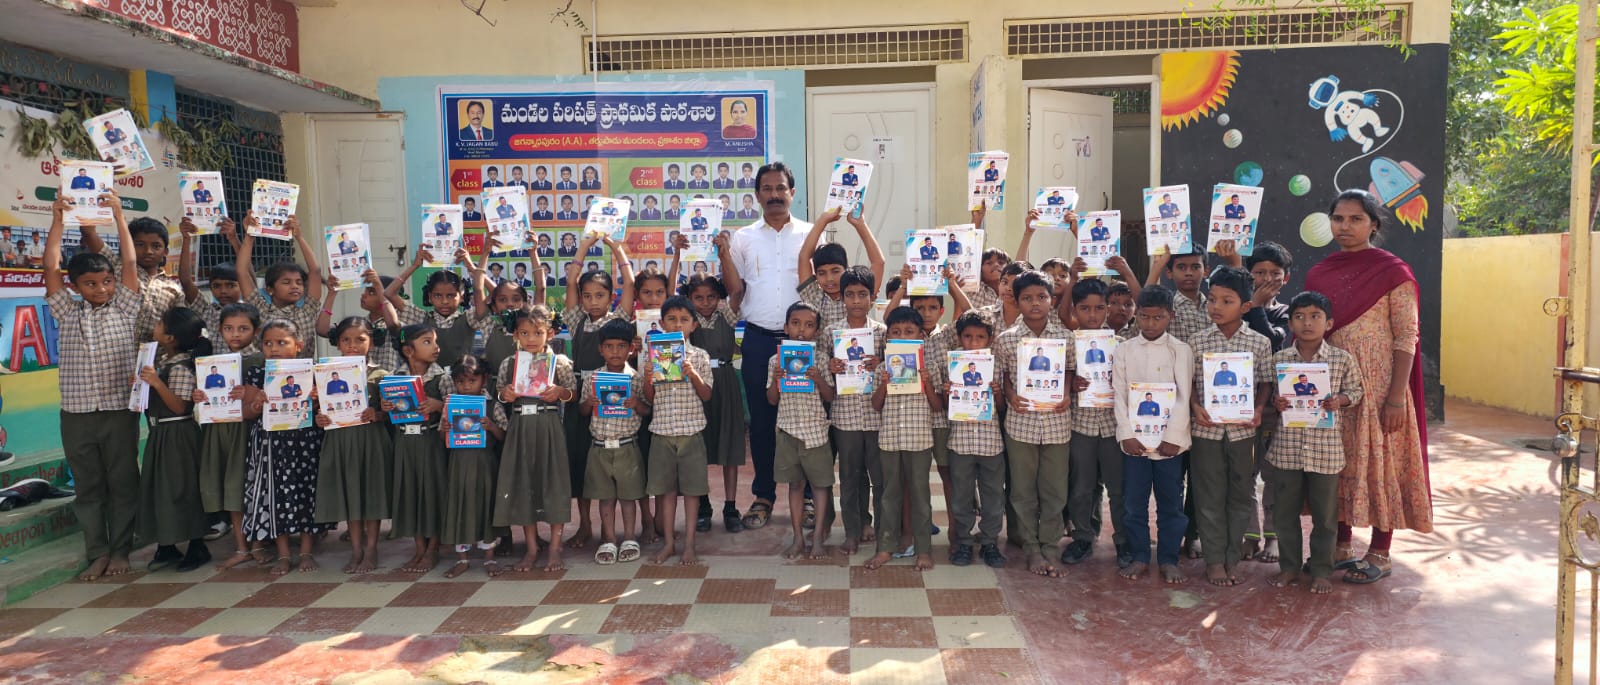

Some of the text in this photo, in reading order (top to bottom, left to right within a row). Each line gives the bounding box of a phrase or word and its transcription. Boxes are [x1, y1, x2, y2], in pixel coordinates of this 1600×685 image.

[501, 101, 716, 129] మండల పరిషత్ ప్రాథమిక పాఠశాల
[456, 179, 479, 188] class
[636, 178, 658, 186] class
[637, 241, 658, 250] class
